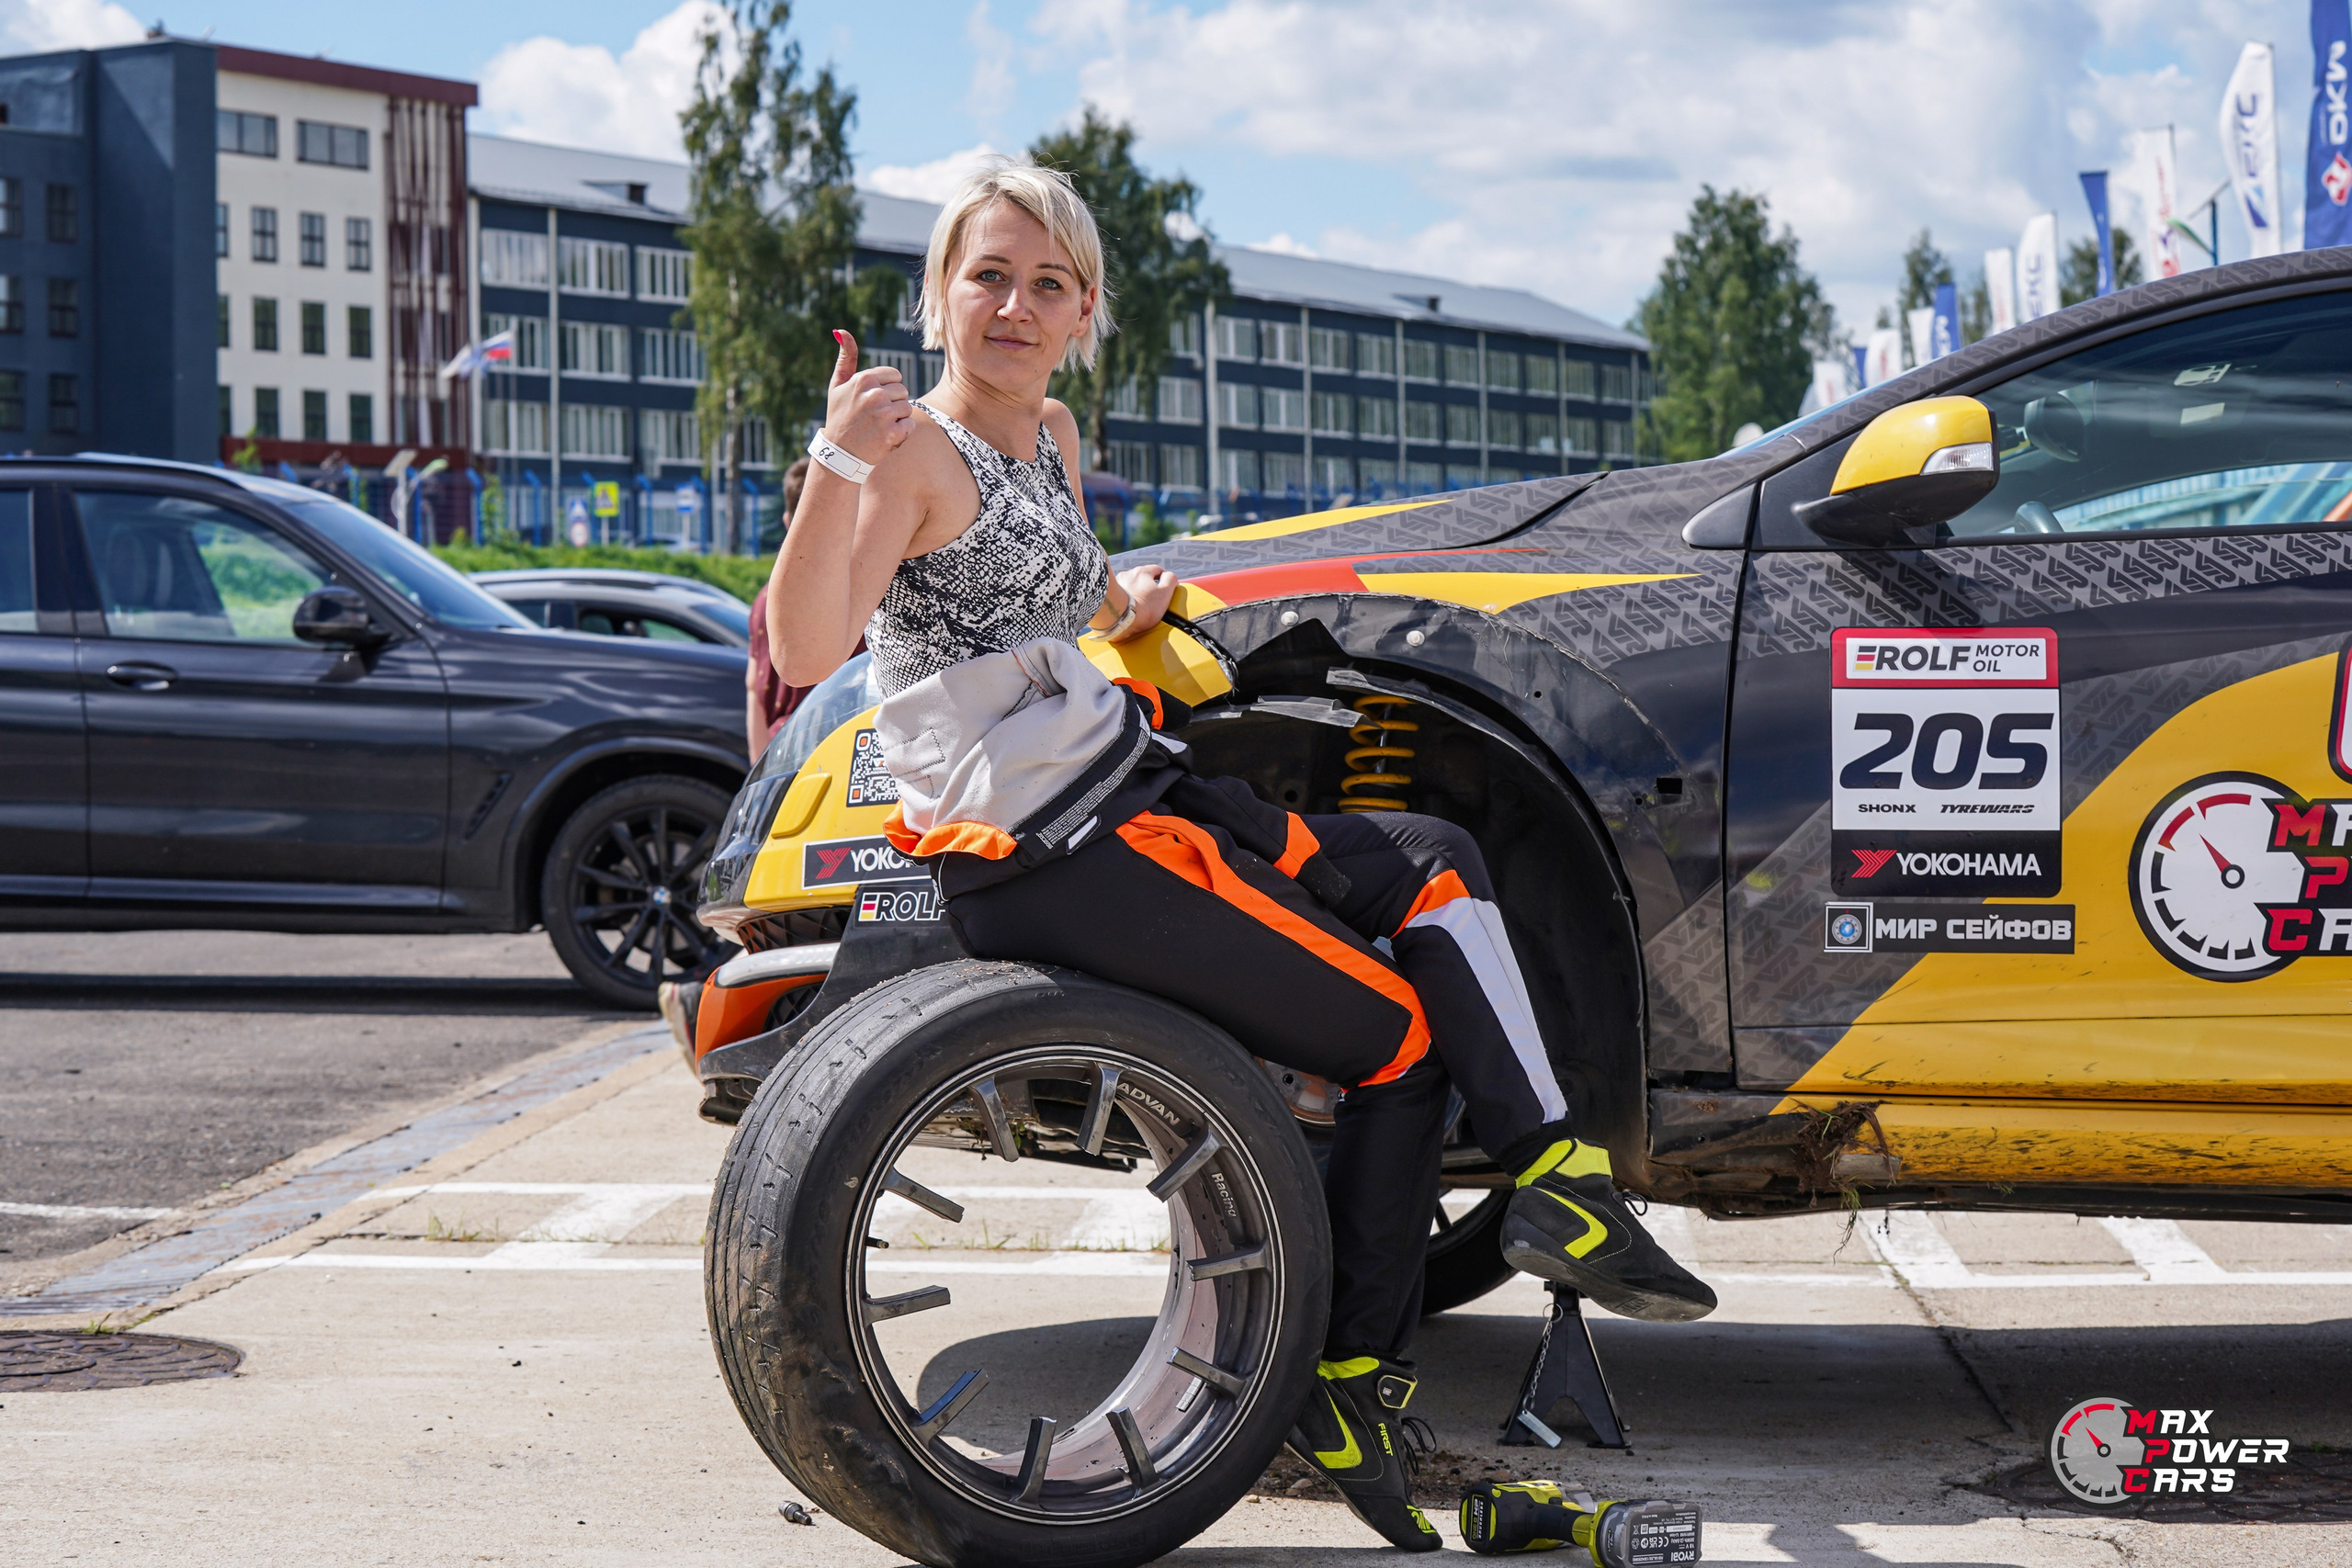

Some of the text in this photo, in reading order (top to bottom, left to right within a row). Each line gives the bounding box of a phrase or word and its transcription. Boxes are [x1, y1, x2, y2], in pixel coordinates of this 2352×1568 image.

[1875, 645, 2040, 671] ROLF MOTOR
[1973, 660, 2002, 672] OIL
[1839, 713, 2055, 789] 205
[1858, 804, 2035, 814] SHONX TYREWARS
[1896, 852, 2041, 876] YOKOHAMA
[1875, 914, 2072, 941] МИР СЕЙФОВ
[1117, 1082, 1181, 1126] ADVAN
[1211, 1172, 1237, 1217] Racing
[1377, 1422, 1394, 1457] FIRST
[1670, 1551, 1695, 1562] RYOBI
